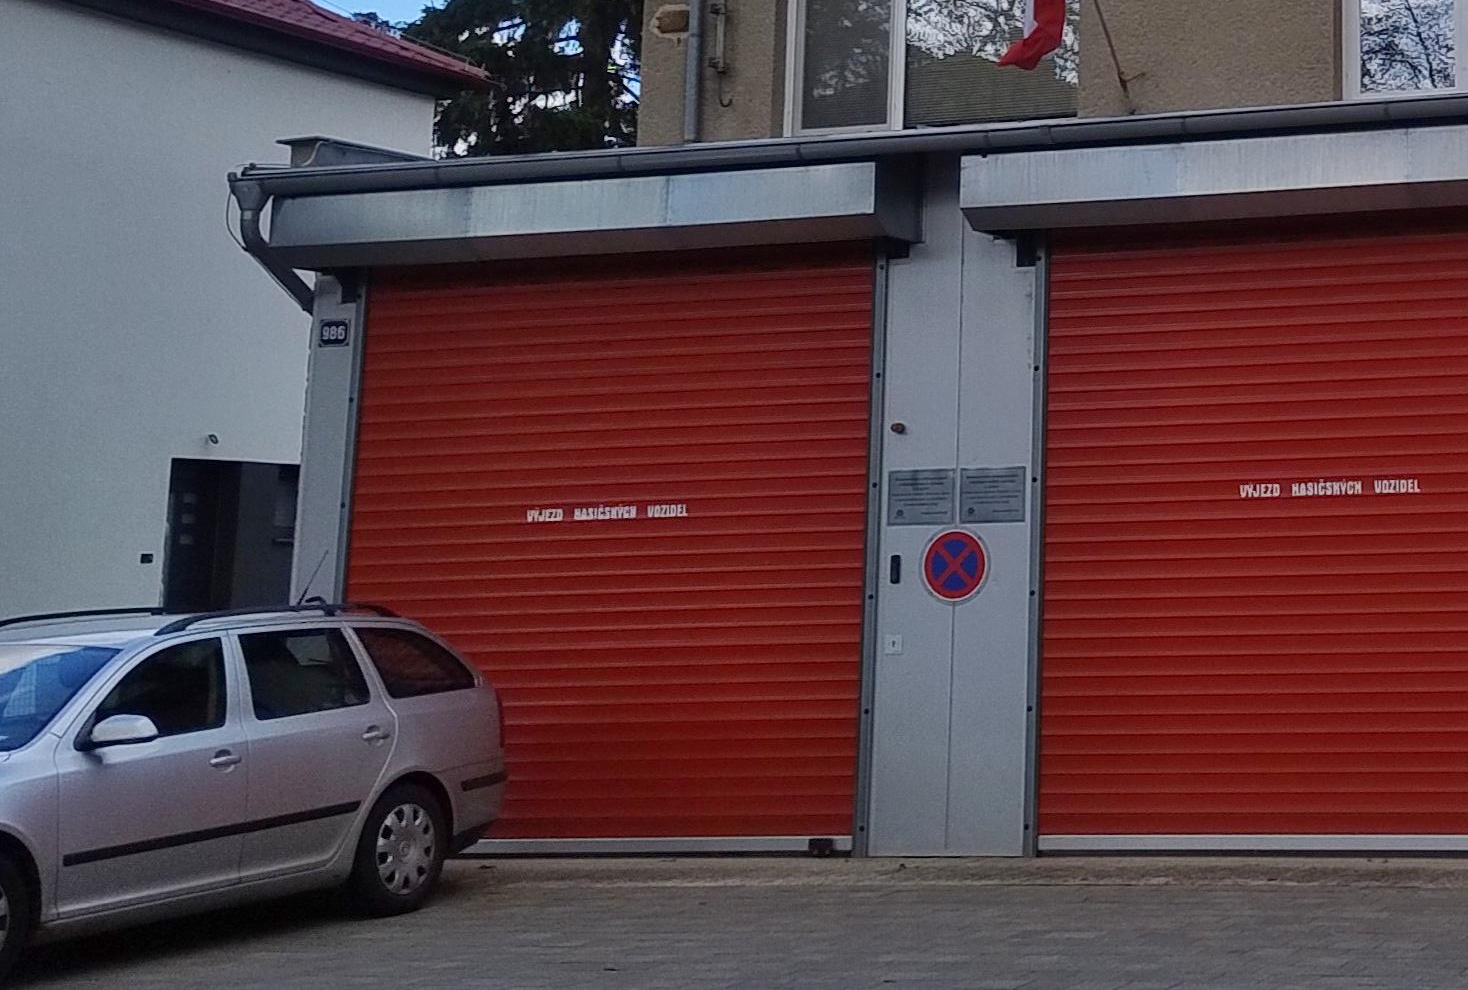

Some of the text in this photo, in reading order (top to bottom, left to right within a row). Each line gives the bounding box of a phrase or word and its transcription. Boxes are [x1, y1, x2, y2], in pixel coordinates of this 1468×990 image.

[322, 325, 346, 340] 986
[1239, 478, 1421, 498] VÝJEZD HASIČSKÝCH VOZIDEL
[526, 503, 689, 523] VÝJEZD HASIČSKÝCH VOZIDEL
